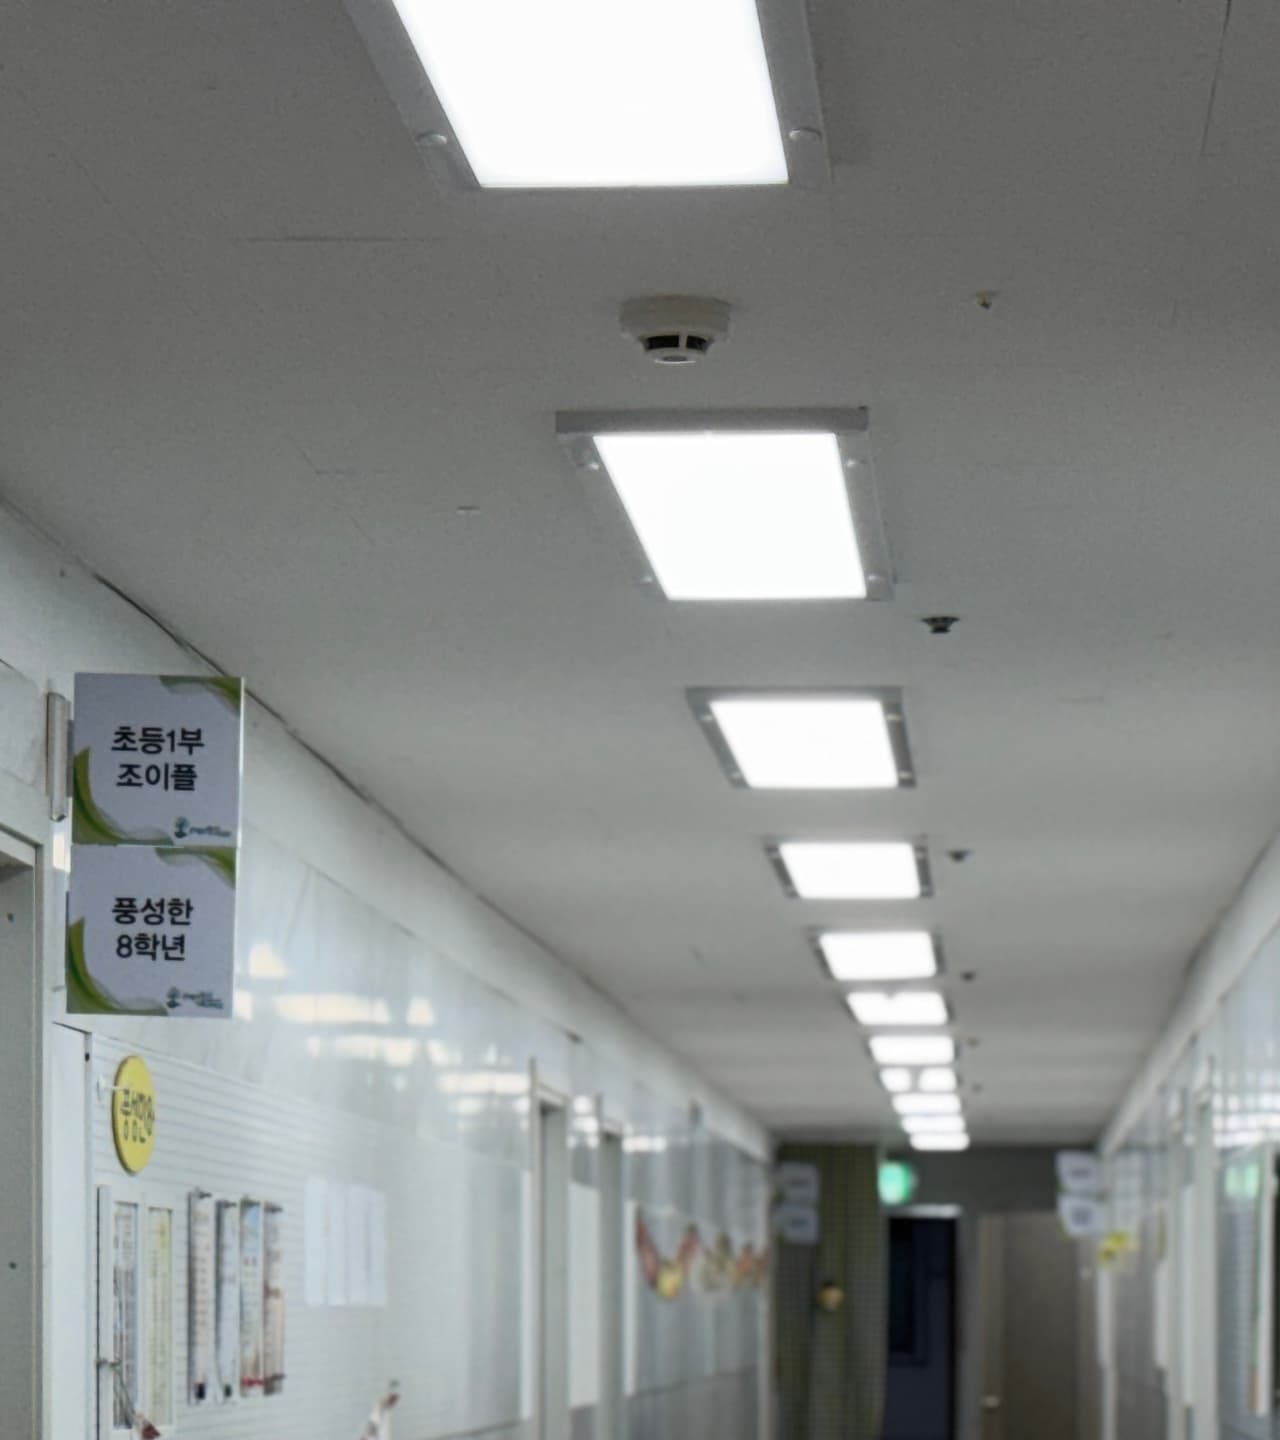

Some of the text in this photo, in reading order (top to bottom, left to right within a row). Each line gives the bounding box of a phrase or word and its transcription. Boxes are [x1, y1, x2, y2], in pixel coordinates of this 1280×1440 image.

[111, 726, 205, 756] 초등1부
[116, 763, 198, 792] 조이플
[112, 897, 194, 926] 풍성한
[116, 932, 186, 961] 8학년
